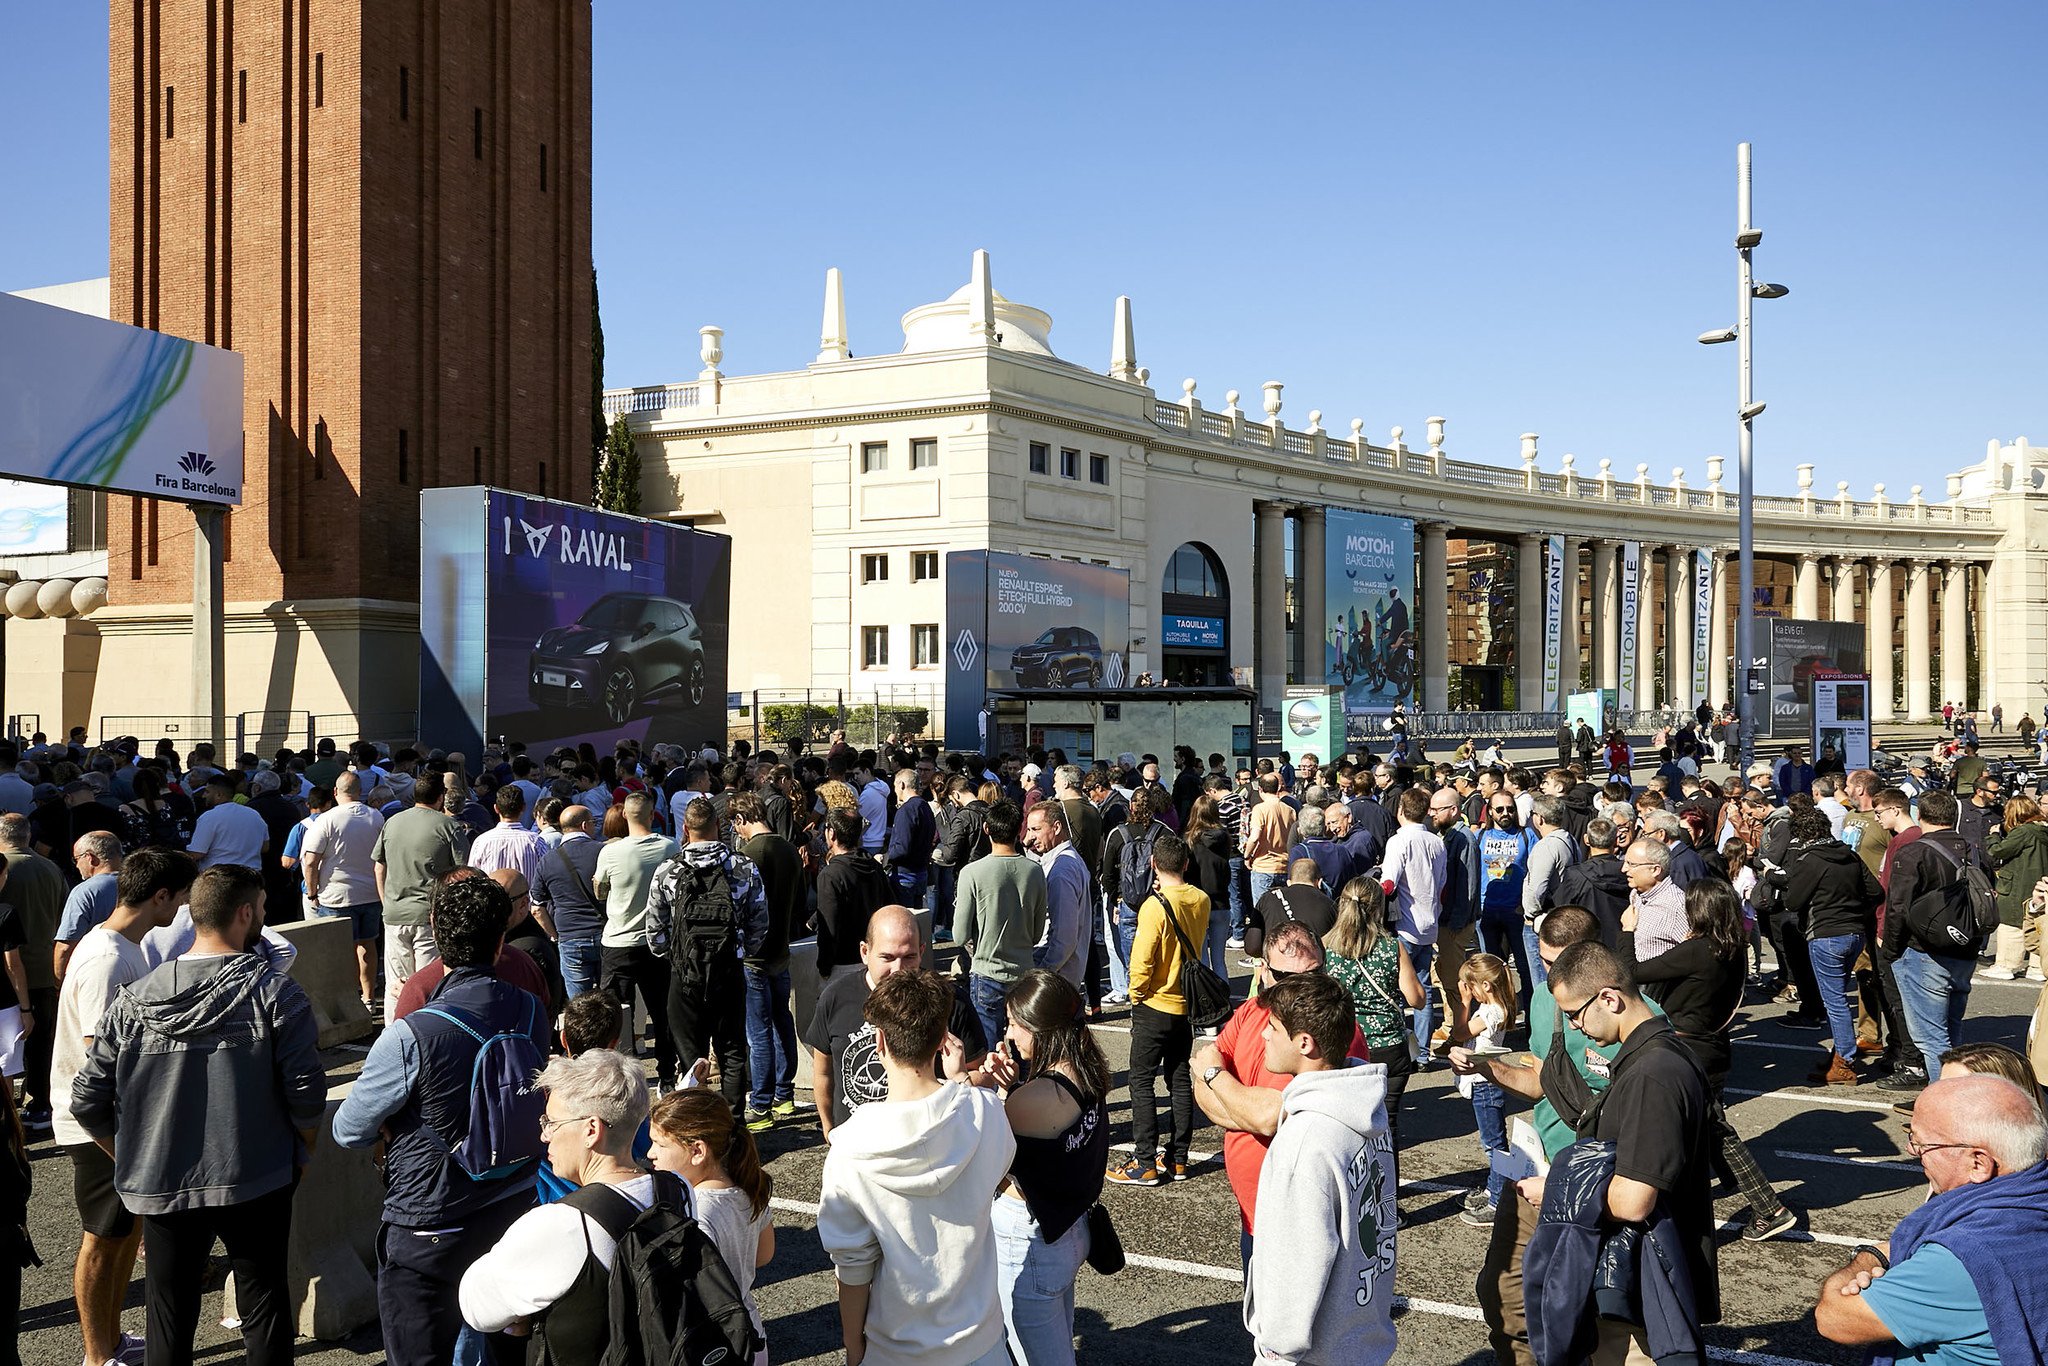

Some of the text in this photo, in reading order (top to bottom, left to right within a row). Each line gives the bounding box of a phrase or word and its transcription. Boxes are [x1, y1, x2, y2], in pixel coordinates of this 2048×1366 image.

[155, 474, 236, 497] Fira Barcelona
[504, 516, 632, 571] I RAVAL
[1346, 535, 1394, 555] MOTOh!
[1345, 553, 1395, 569] BARCELONA
[998, 569, 1018, 579] NUEVO
[998, 578, 1064, 595] RENAULT ESPACE
[998, 590, 1073, 608] E-TECH FULL HYBRID
[998, 602, 1027, 615] 200 CV
[1176, 619, 1209, 629] TAQUILLA
[1547, 554, 1561, 692] ELECTRITZANT
[1622, 559, 1638, 692] AUTOMOBILE
[1695, 565, 1709, 693] ELECTRITZANT
[1775, 703, 1800, 715] KIA
[1356, 1236, 1396, 1305] JS
